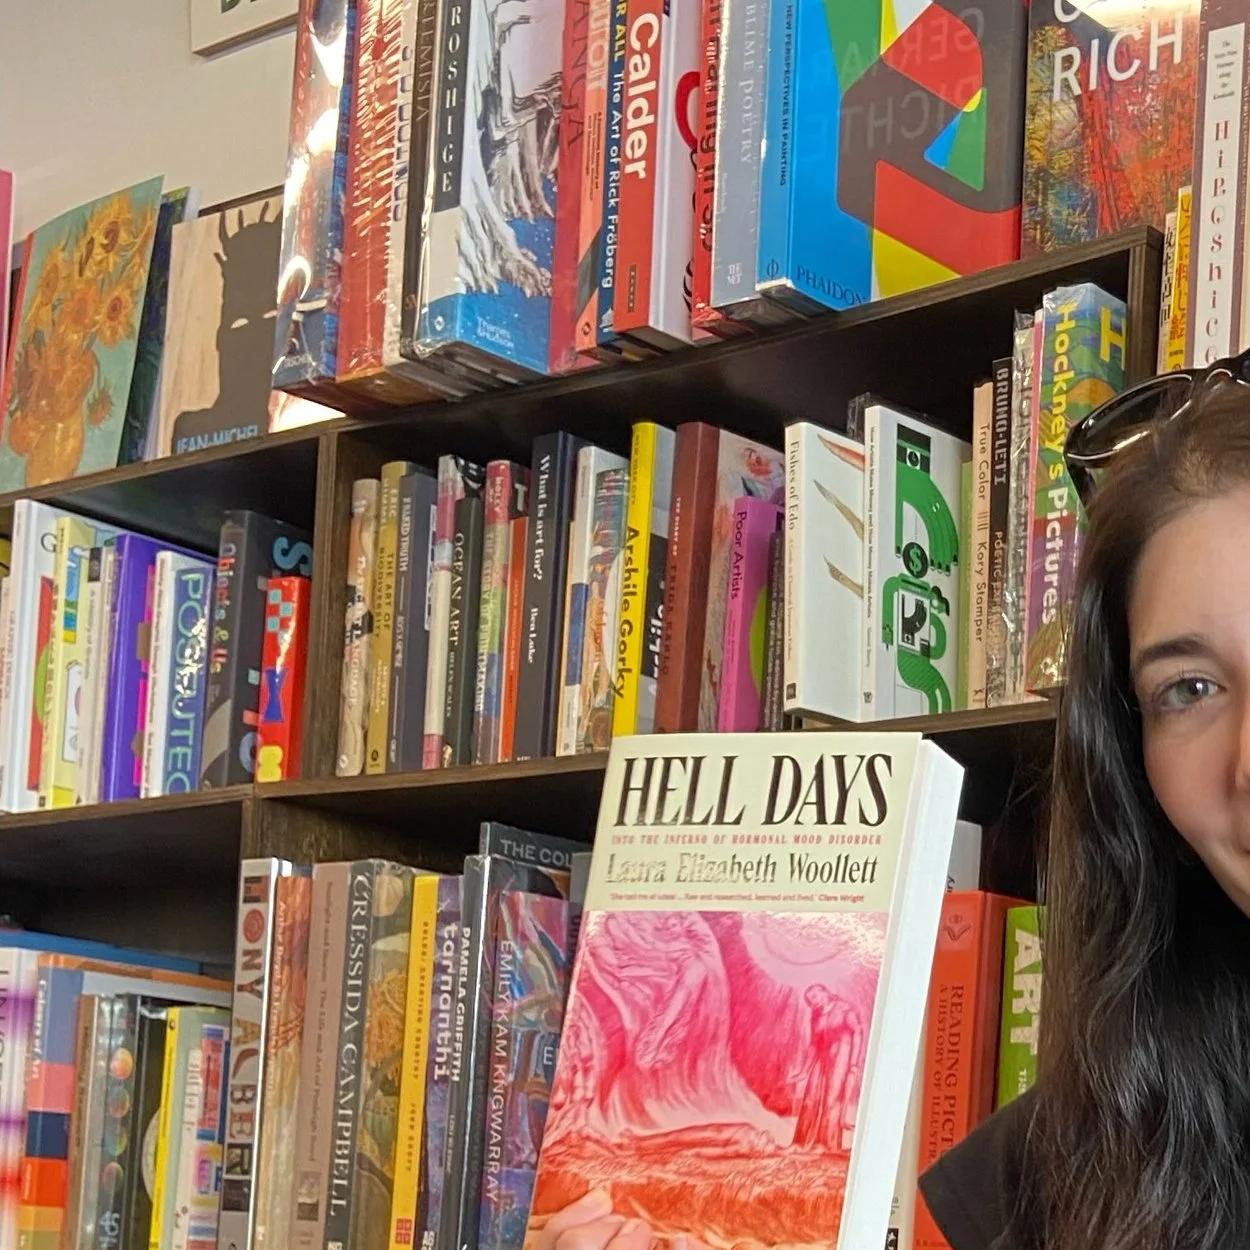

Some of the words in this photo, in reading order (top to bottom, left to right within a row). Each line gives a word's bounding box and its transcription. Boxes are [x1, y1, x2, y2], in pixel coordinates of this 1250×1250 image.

[1052, 9, 1186, 102] RICH
[623, 13, 661, 181] Calder
[978, 423, 991, 455] True
[977, 461, 989, 502] Color
[734, 511, 748, 549] Poor
[975, 541, 988, 575] Kory
[451, 532, 464, 604] OCEAN
[619, 526, 641, 613] Arshile
[730, 554, 745, 602] Artists
[972, 579, 987, 643] Stamper
[614, 619, 635, 700] Gorky
[613, 754, 747, 827] HELL
[760, 752, 893, 827] DAYS
[605, 853, 668, 884] Laura
[675, 852, 778, 884] Elizabeth
[789, 852, 879, 884] Woollett
[341, 870, 372, 1032] CRESSIDA
[457, 926, 471, 998] PAMELA
[499, 937, 513, 998] EMILY
[433, 921, 459, 1081] tarnanthi
[1009, 928, 1041, 1056] ART
[450, 1002, 467, 1082] GRIFFITH
[494, 1004, 509, 1055] KAM
[329, 1040, 358, 1217] CAMPBELL
[483, 1060, 505, 1202] KNGWARRAY
